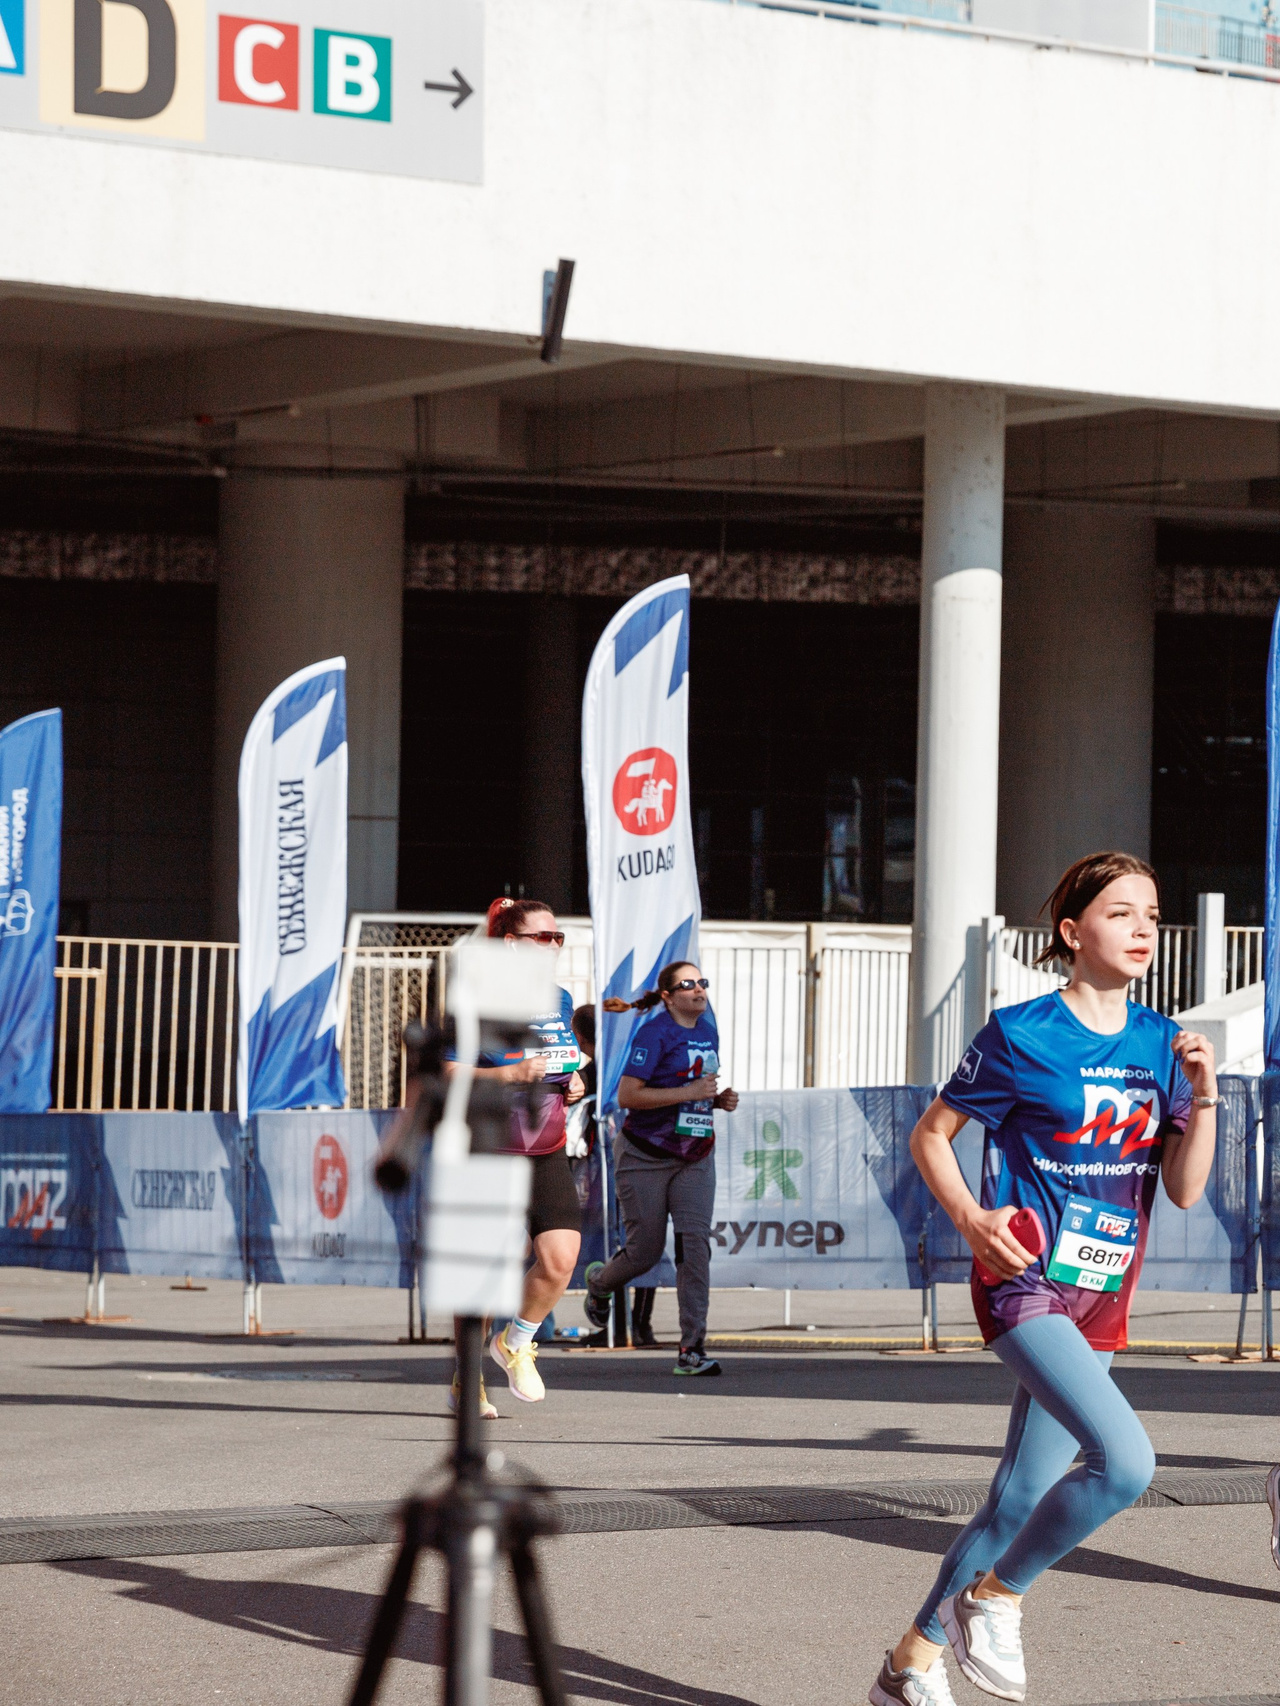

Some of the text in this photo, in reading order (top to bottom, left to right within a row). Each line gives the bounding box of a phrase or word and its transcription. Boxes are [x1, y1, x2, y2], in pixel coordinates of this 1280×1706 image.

[74, 0, 176, 119] D
[234, 24, 286, 102] C
[328, 35, 380, 114] B
[1080, 1067, 1154, 1080] МАРАФОН
[1033, 1157, 1104, 1176] НИЖНИЙ
[1078, 1245, 1123, 1267] 6817
[1089, 1278, 1104, 1286] KM
